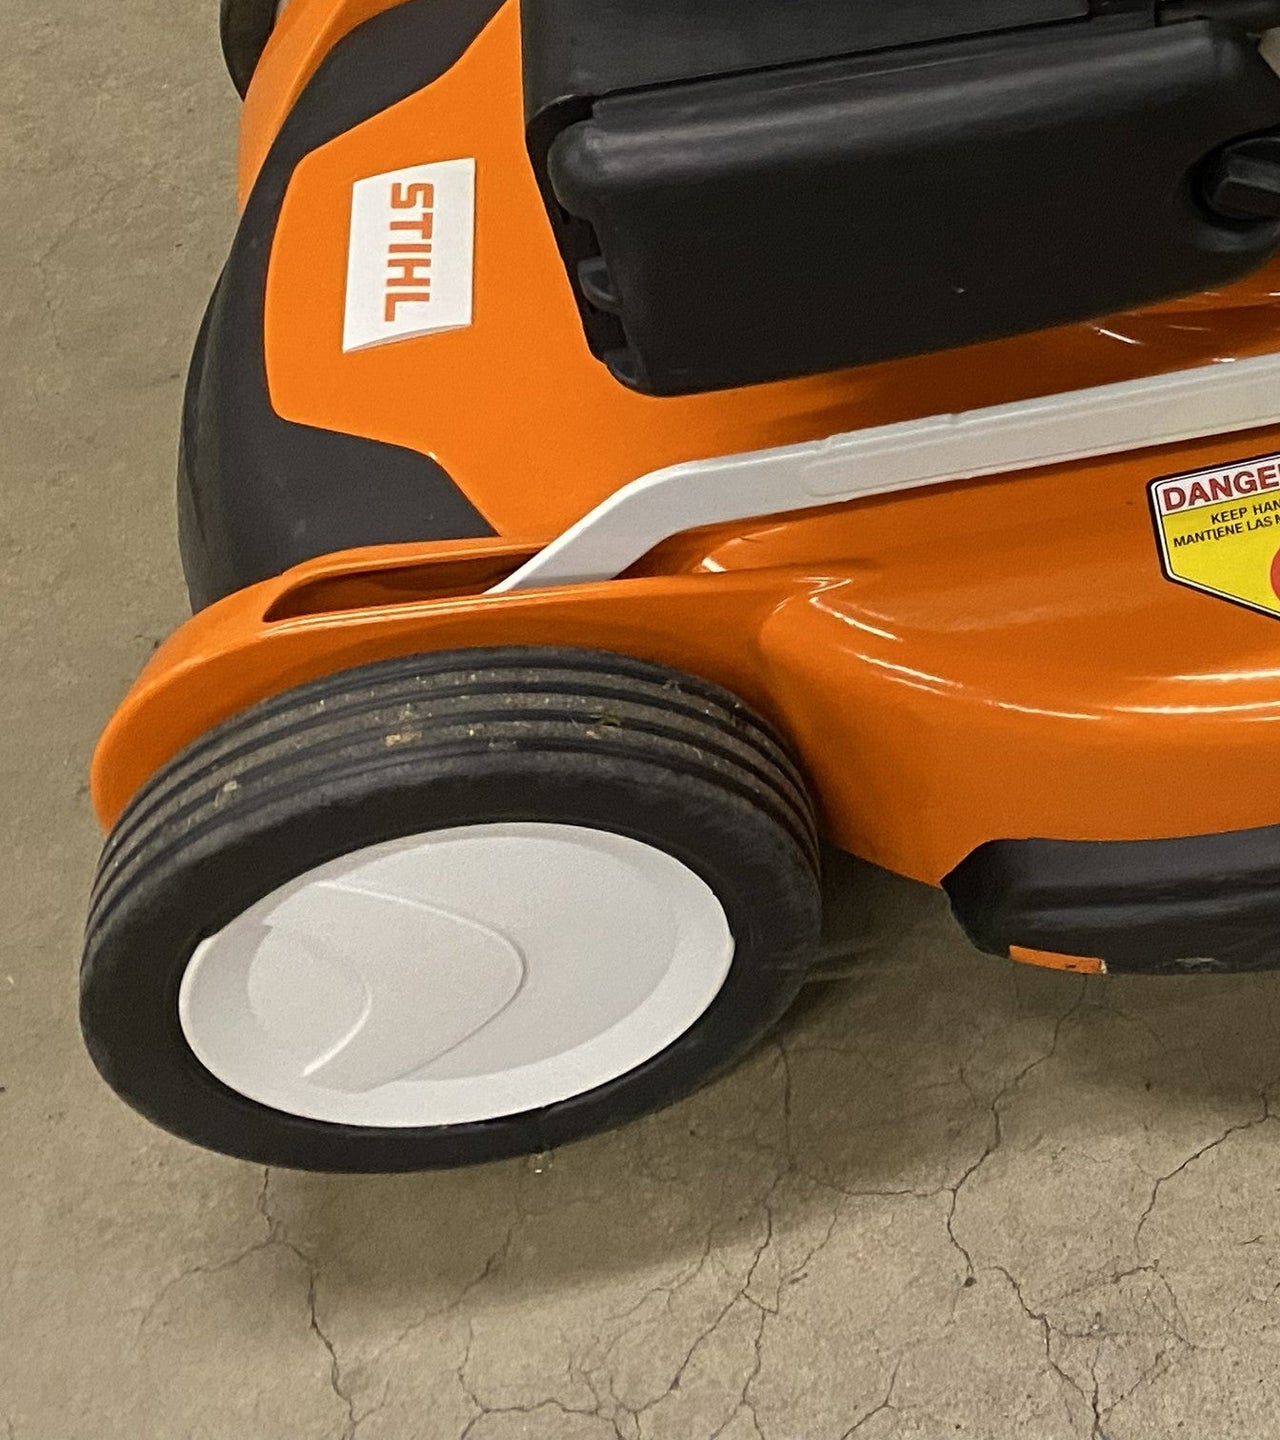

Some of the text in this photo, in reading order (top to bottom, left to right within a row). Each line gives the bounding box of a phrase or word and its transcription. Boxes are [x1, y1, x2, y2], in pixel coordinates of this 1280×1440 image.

[385, 182, 434, 322] STIHL
[1174, 523, 1243, 547] MANTIENE
[1246, 515, 1273, 531] LAS
[1210, 506, 1247, 524] KEEP
